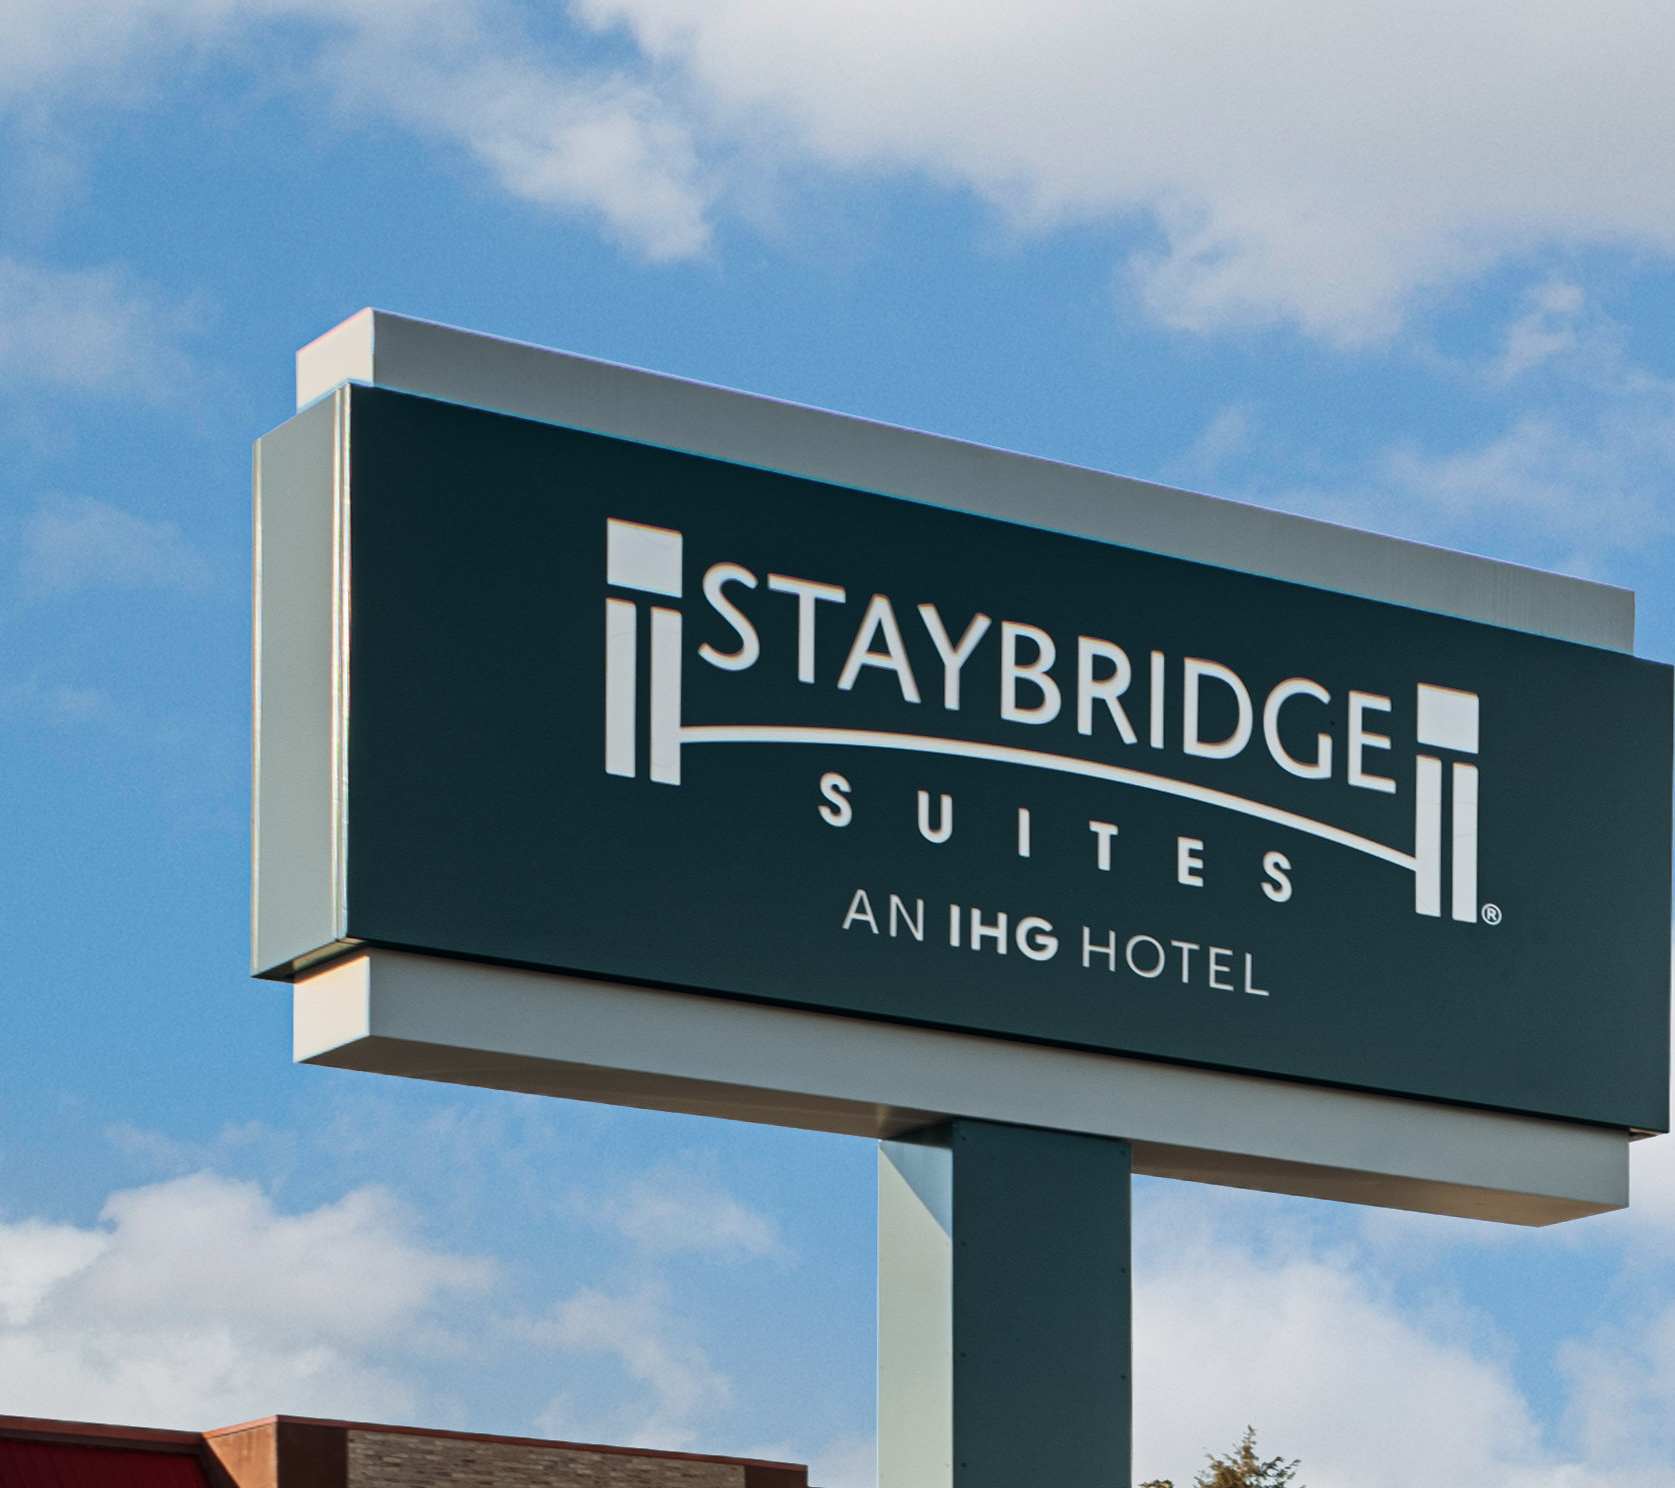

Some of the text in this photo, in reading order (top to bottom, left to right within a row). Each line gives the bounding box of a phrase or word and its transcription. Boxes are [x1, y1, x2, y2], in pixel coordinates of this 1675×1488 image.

[698, 561, 1398, 795] STAYBRIDGE
[817, 771, 1294, 904] SUITES
[841, 888, 1271, 998] AN IHG HOTEL
